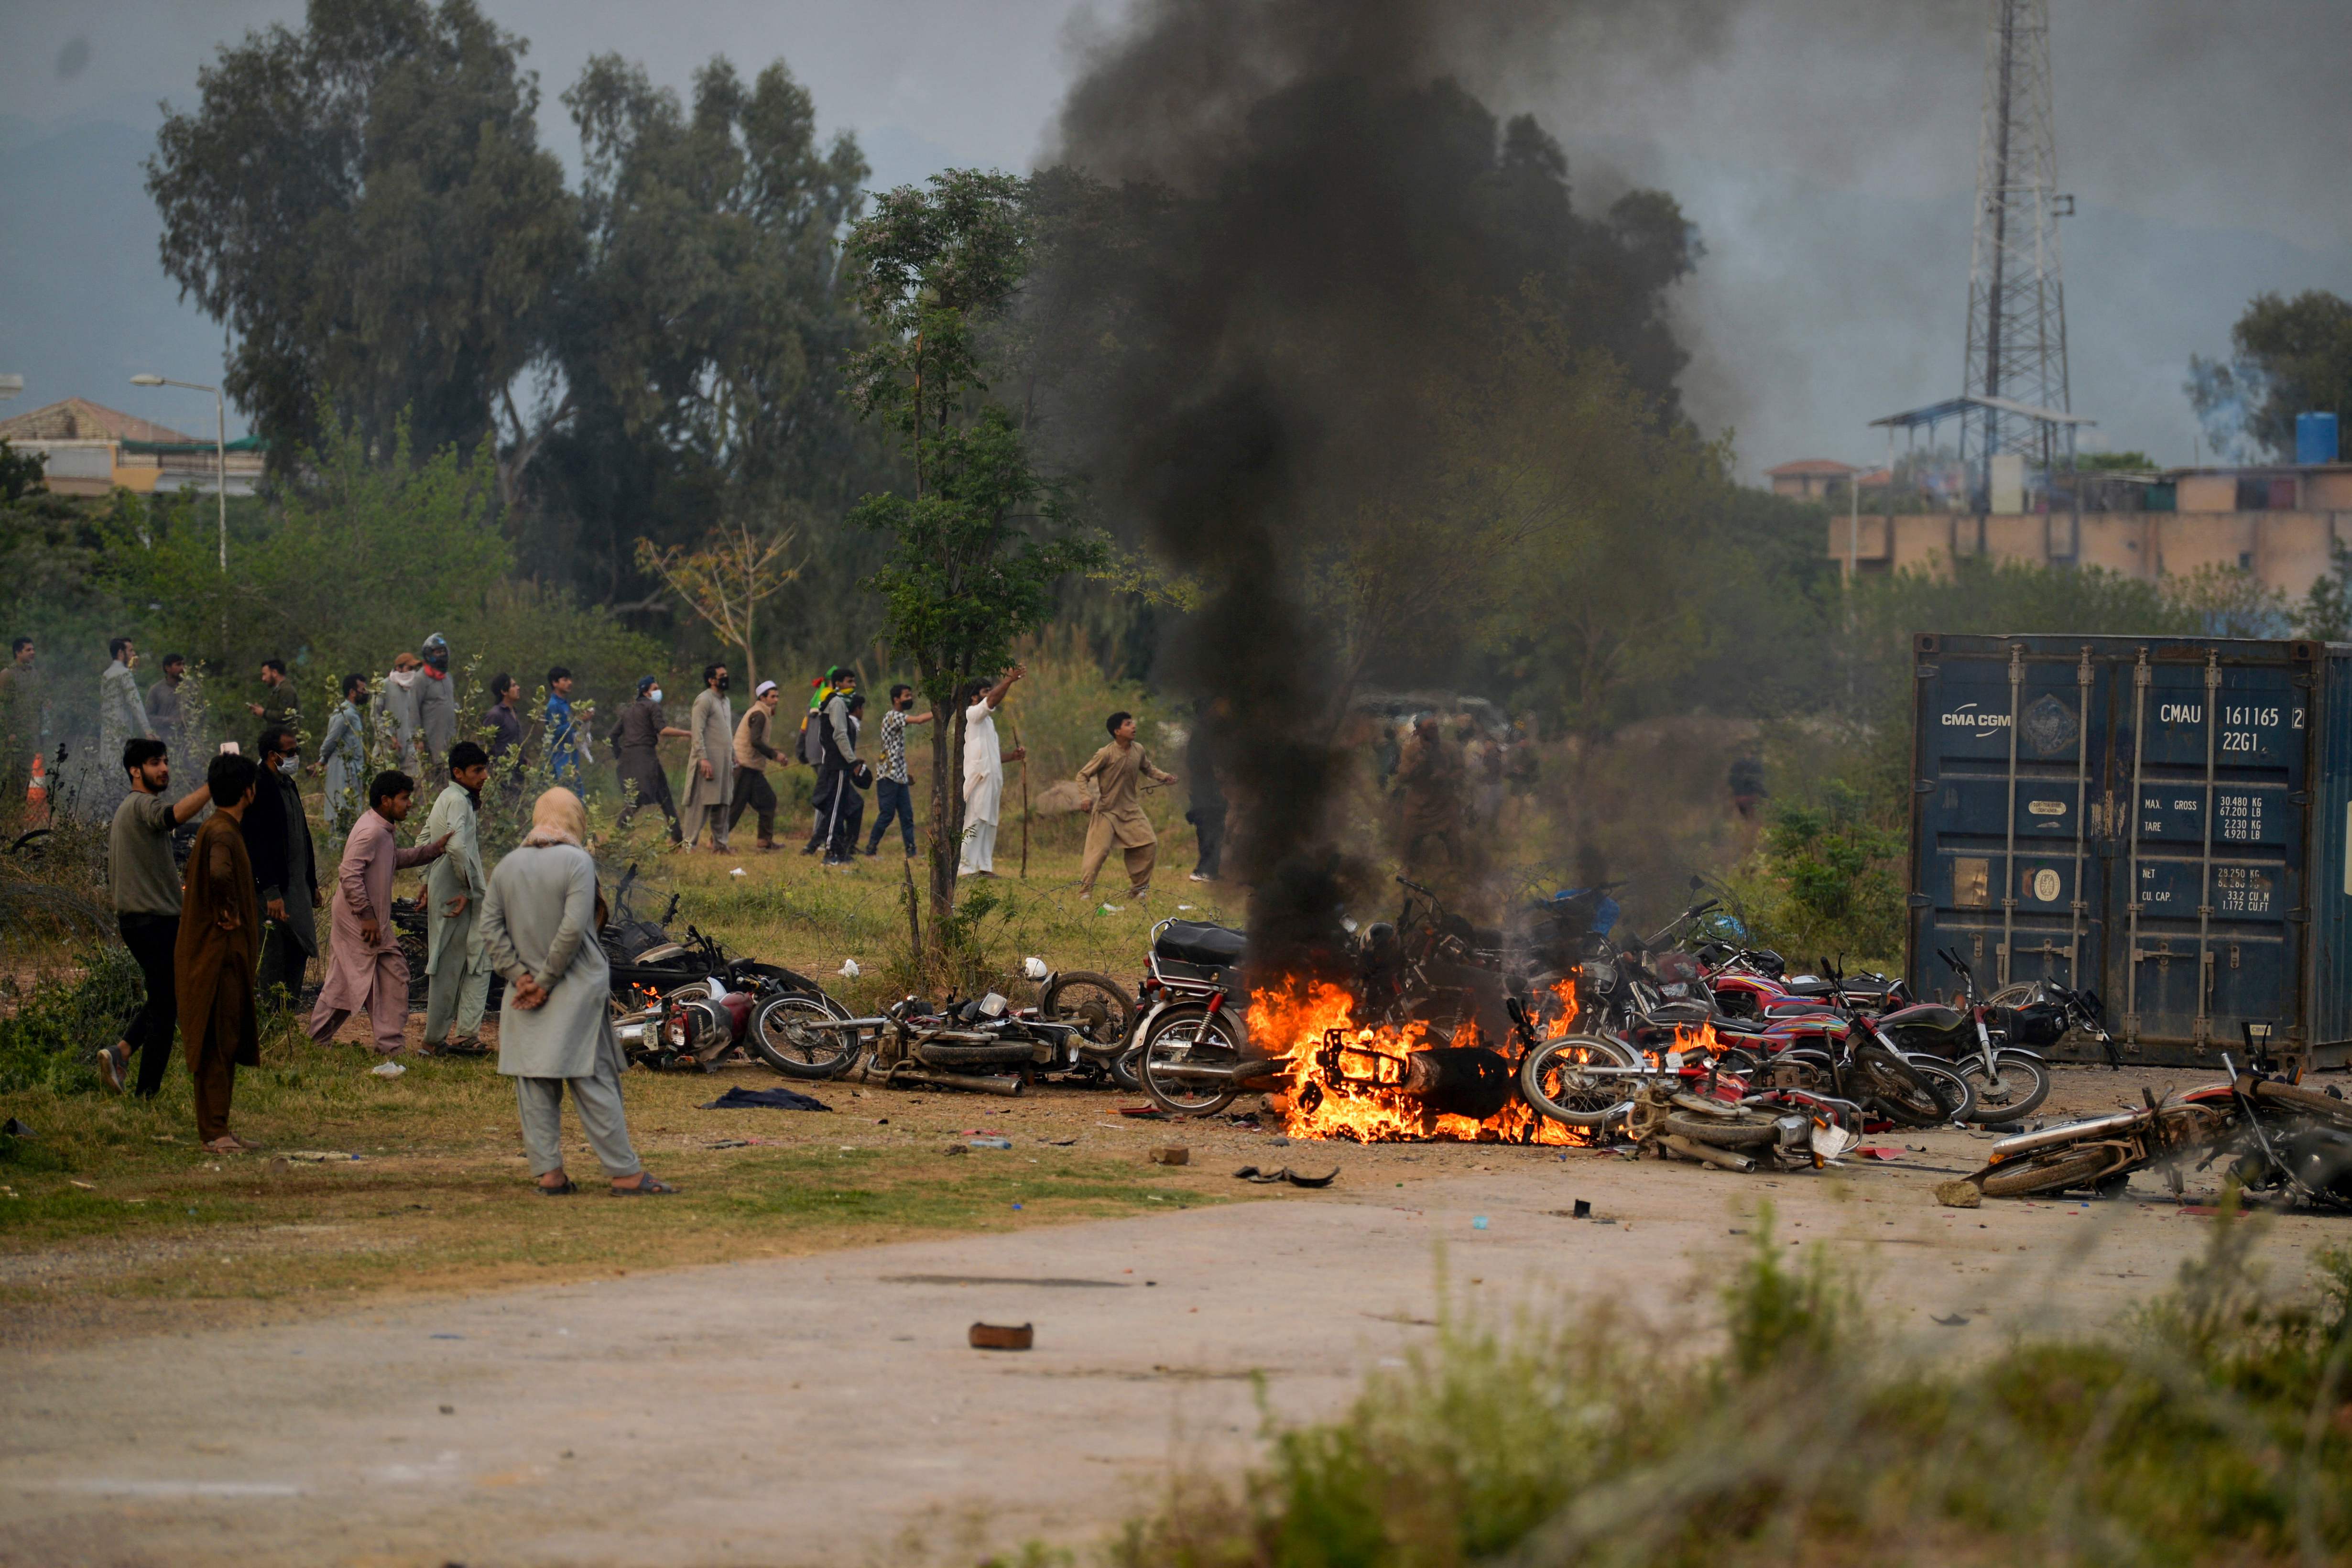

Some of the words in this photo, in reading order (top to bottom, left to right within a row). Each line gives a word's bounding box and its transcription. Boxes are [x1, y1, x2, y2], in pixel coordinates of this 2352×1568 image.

[1942, 714, 1975, 726] CMA
[1978, 715, 2011, 726] CGM
[2160, 704, 2201, 723] CMAU
[2226, 706, 2278, 727] 161165
[2294, 709, 2303, 727] 2
[2223, 732, 2257, 751] 22G1
[2145, 799, 2162, 809] MAX.
[2174, 800, 2197, 810] GROSS
[2221, 796, 2247, 806] 30.480
[2252, 797, 2262, 807] KG
[2220, 806, 2247, 817] 67.200
[2252, 807, 2261, 817] LB
[2145, 821, 2161, 832] TARE
[2224, 819, 2247, 829] 2.230
[2251, 820, 2261, 830] KG
[2224, 829, 2246, 839] 4.920
[2251, 830, 2260, 840] LB
[2143, 869, 2155, 878] NET
[2218, 868, 2245, 878] 28.250
[2250, 869, 2259, 879] KG
[2142, 891, 2153, 901] CU.
[2156, 892, 2171, 902] CAP.
[2227, 891, 2244, 901] 33.2
[2248, 902, 2268, 912] CU.FT
